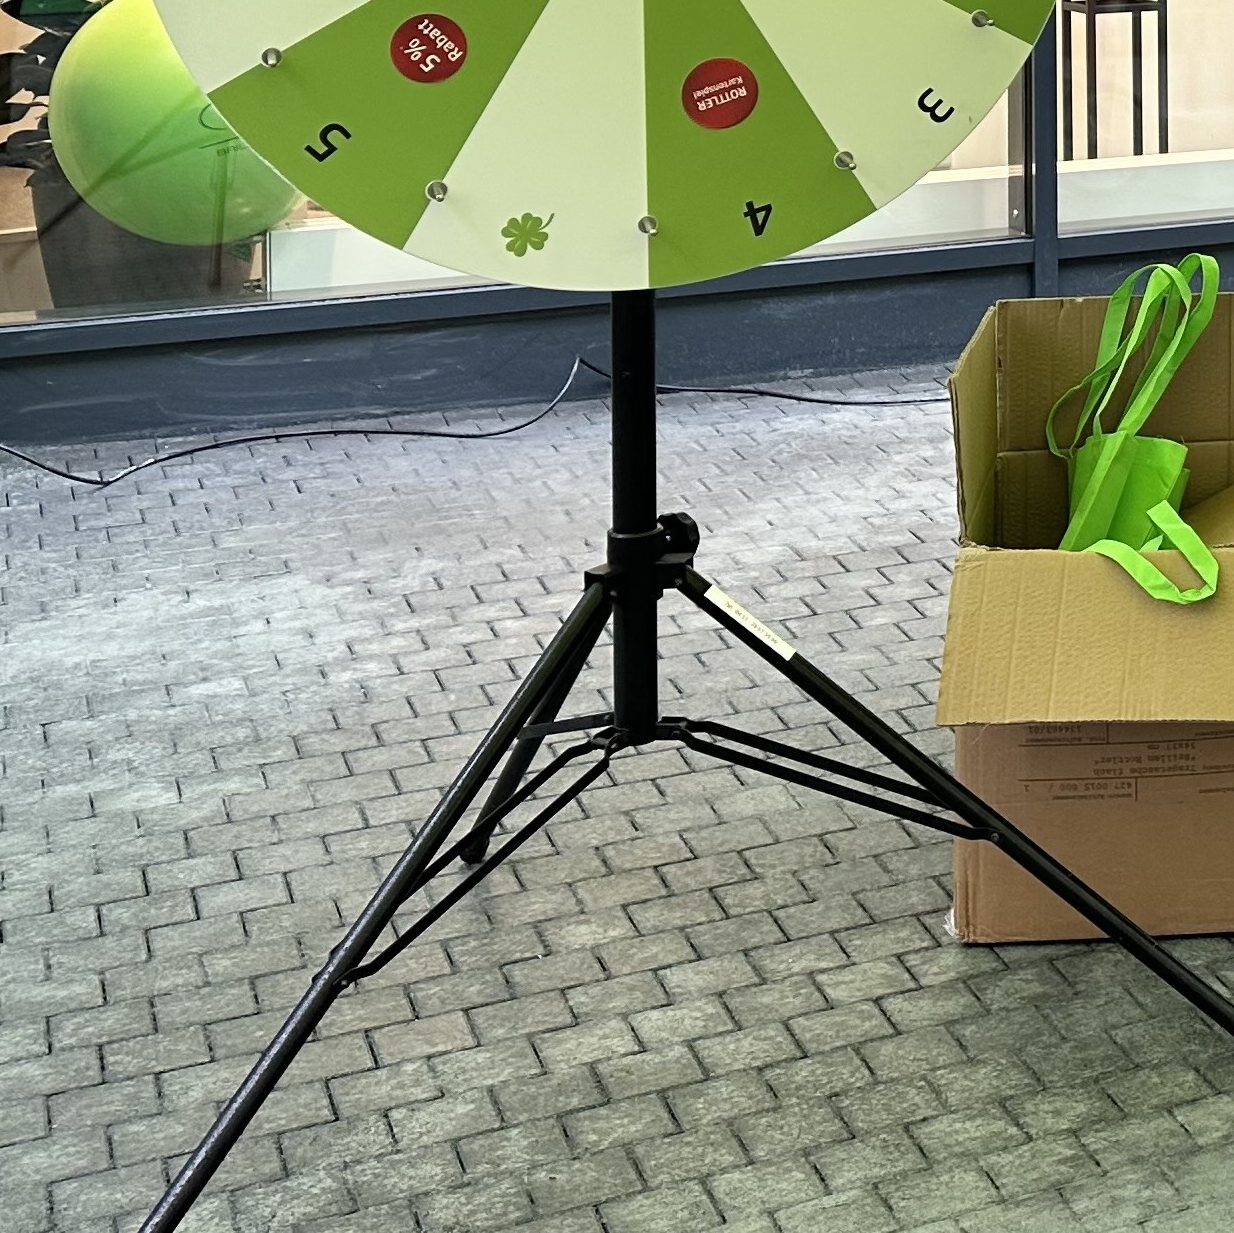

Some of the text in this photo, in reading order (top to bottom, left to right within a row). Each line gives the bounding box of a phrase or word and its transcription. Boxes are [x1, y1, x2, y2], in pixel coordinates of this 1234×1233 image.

[417, 18, 465, 64] Rabatt
[692, 75, 744, 99] Kartenspiel
[696, 85, 748, 112] ROTTLER
[917, 87, 955, 124] 3
[304, 122, 352, 163] 5
[743, 200, 773, 238] 4
